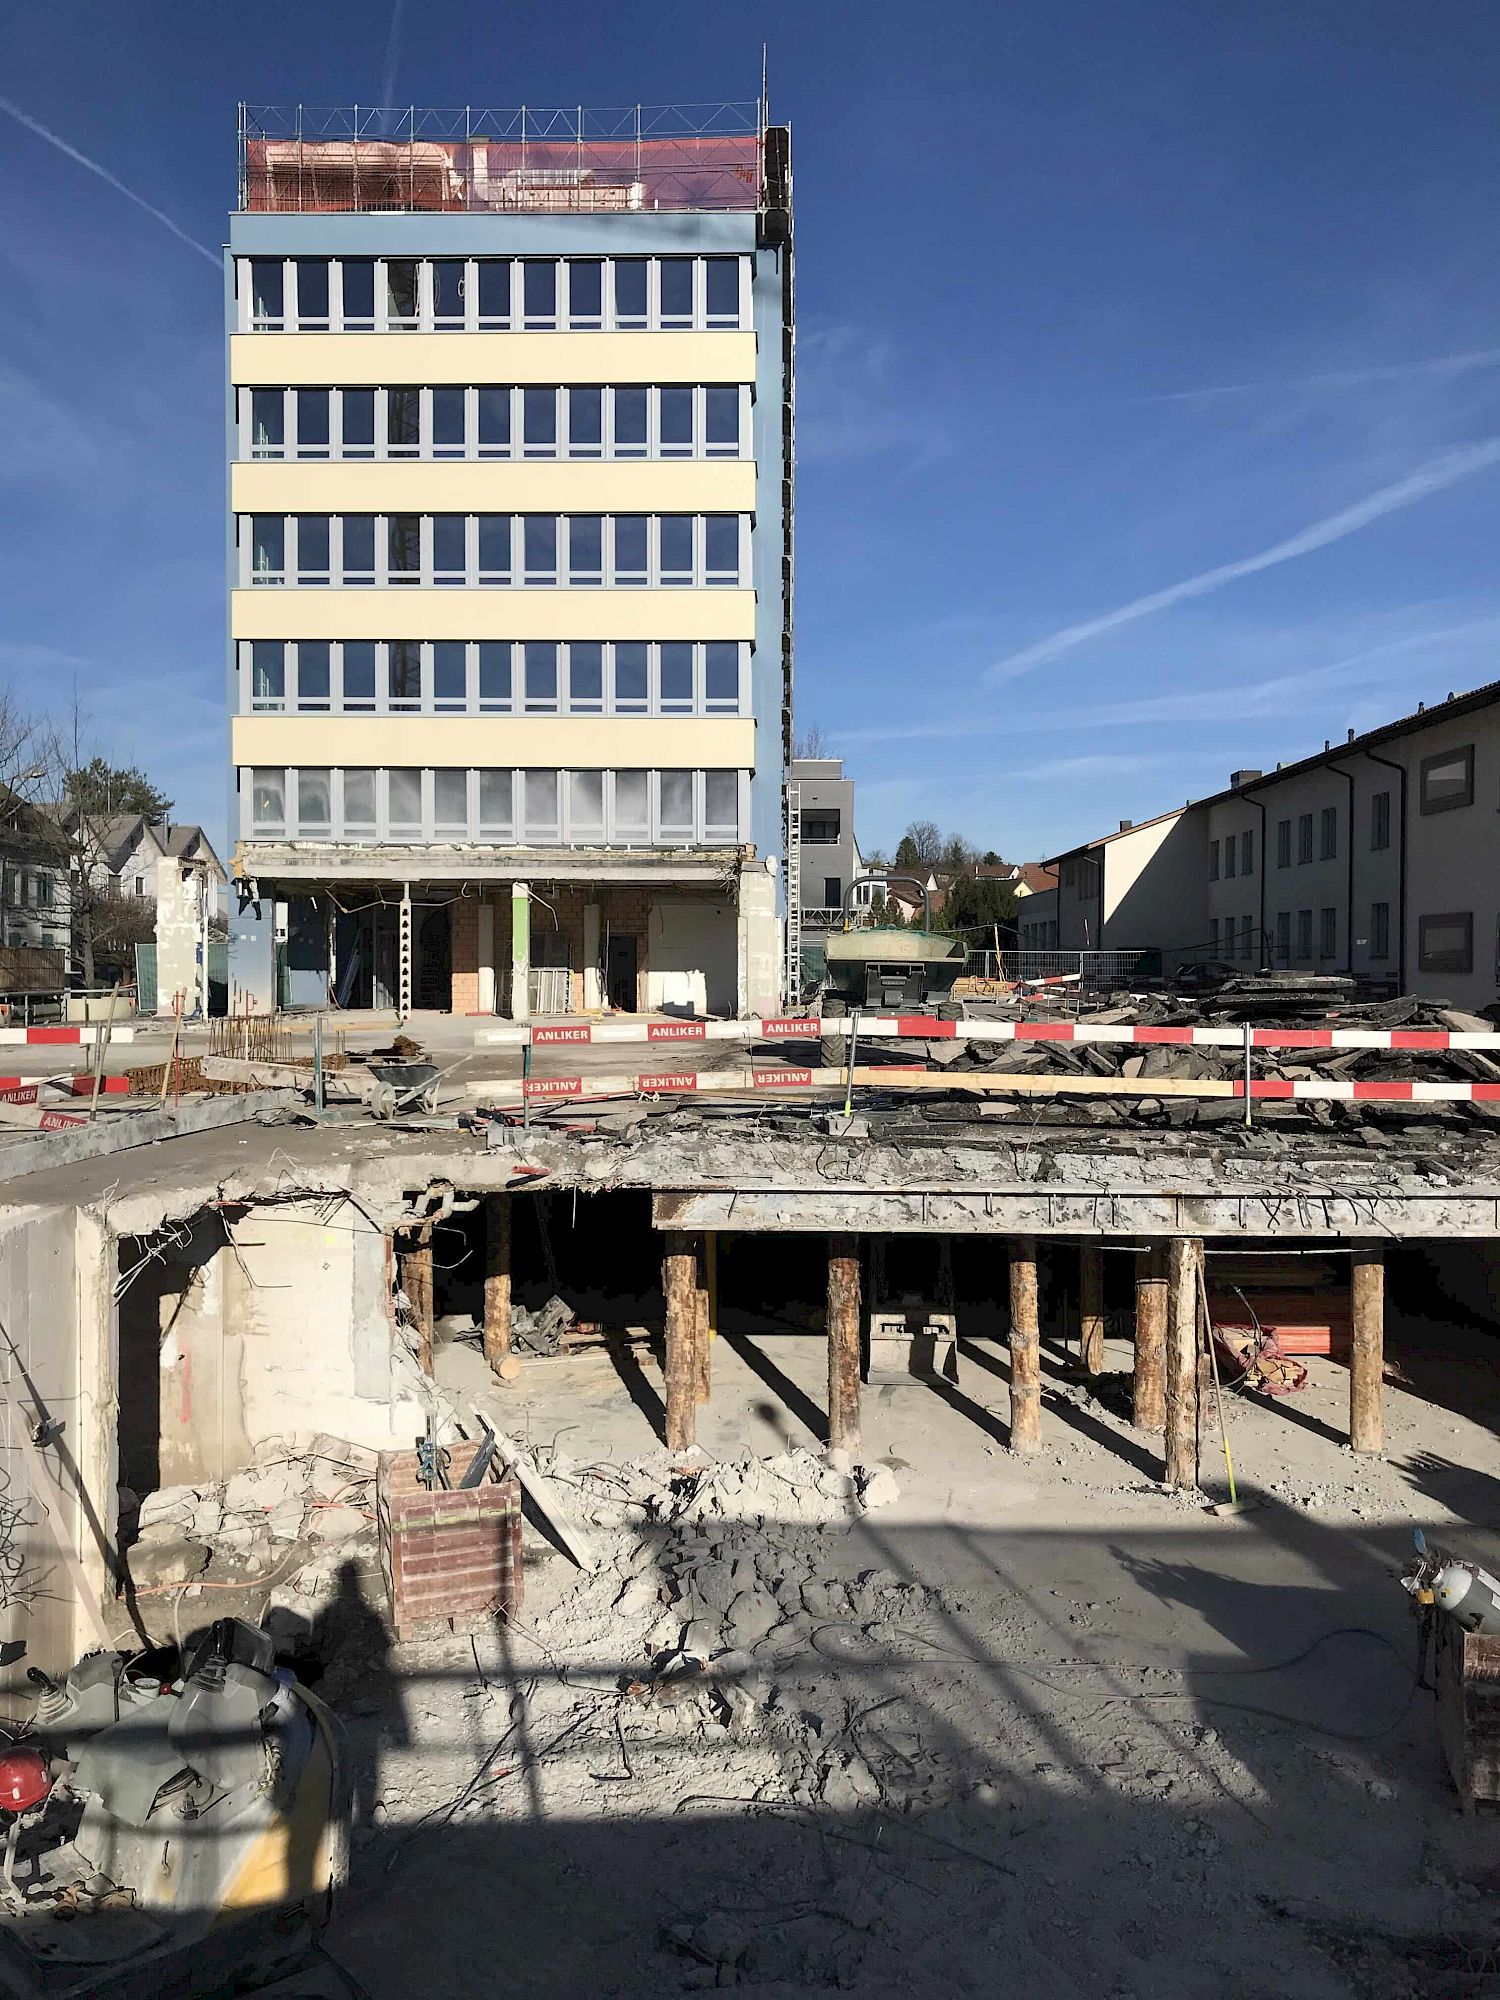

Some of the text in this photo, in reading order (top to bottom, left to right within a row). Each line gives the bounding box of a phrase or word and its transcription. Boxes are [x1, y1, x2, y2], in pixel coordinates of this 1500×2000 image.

[652, 1027, 702, 1036] ANLIKER
[767, 1023, 818, 1032] ANLIKER
[536, 1030, 588, 1040] ANLIKER
[642, 1076, 693, 1087] ANLIKER
[758, 1071, 808, 1083] ANLIKER
[2, 1090, 36, 1103] ANLIKER
